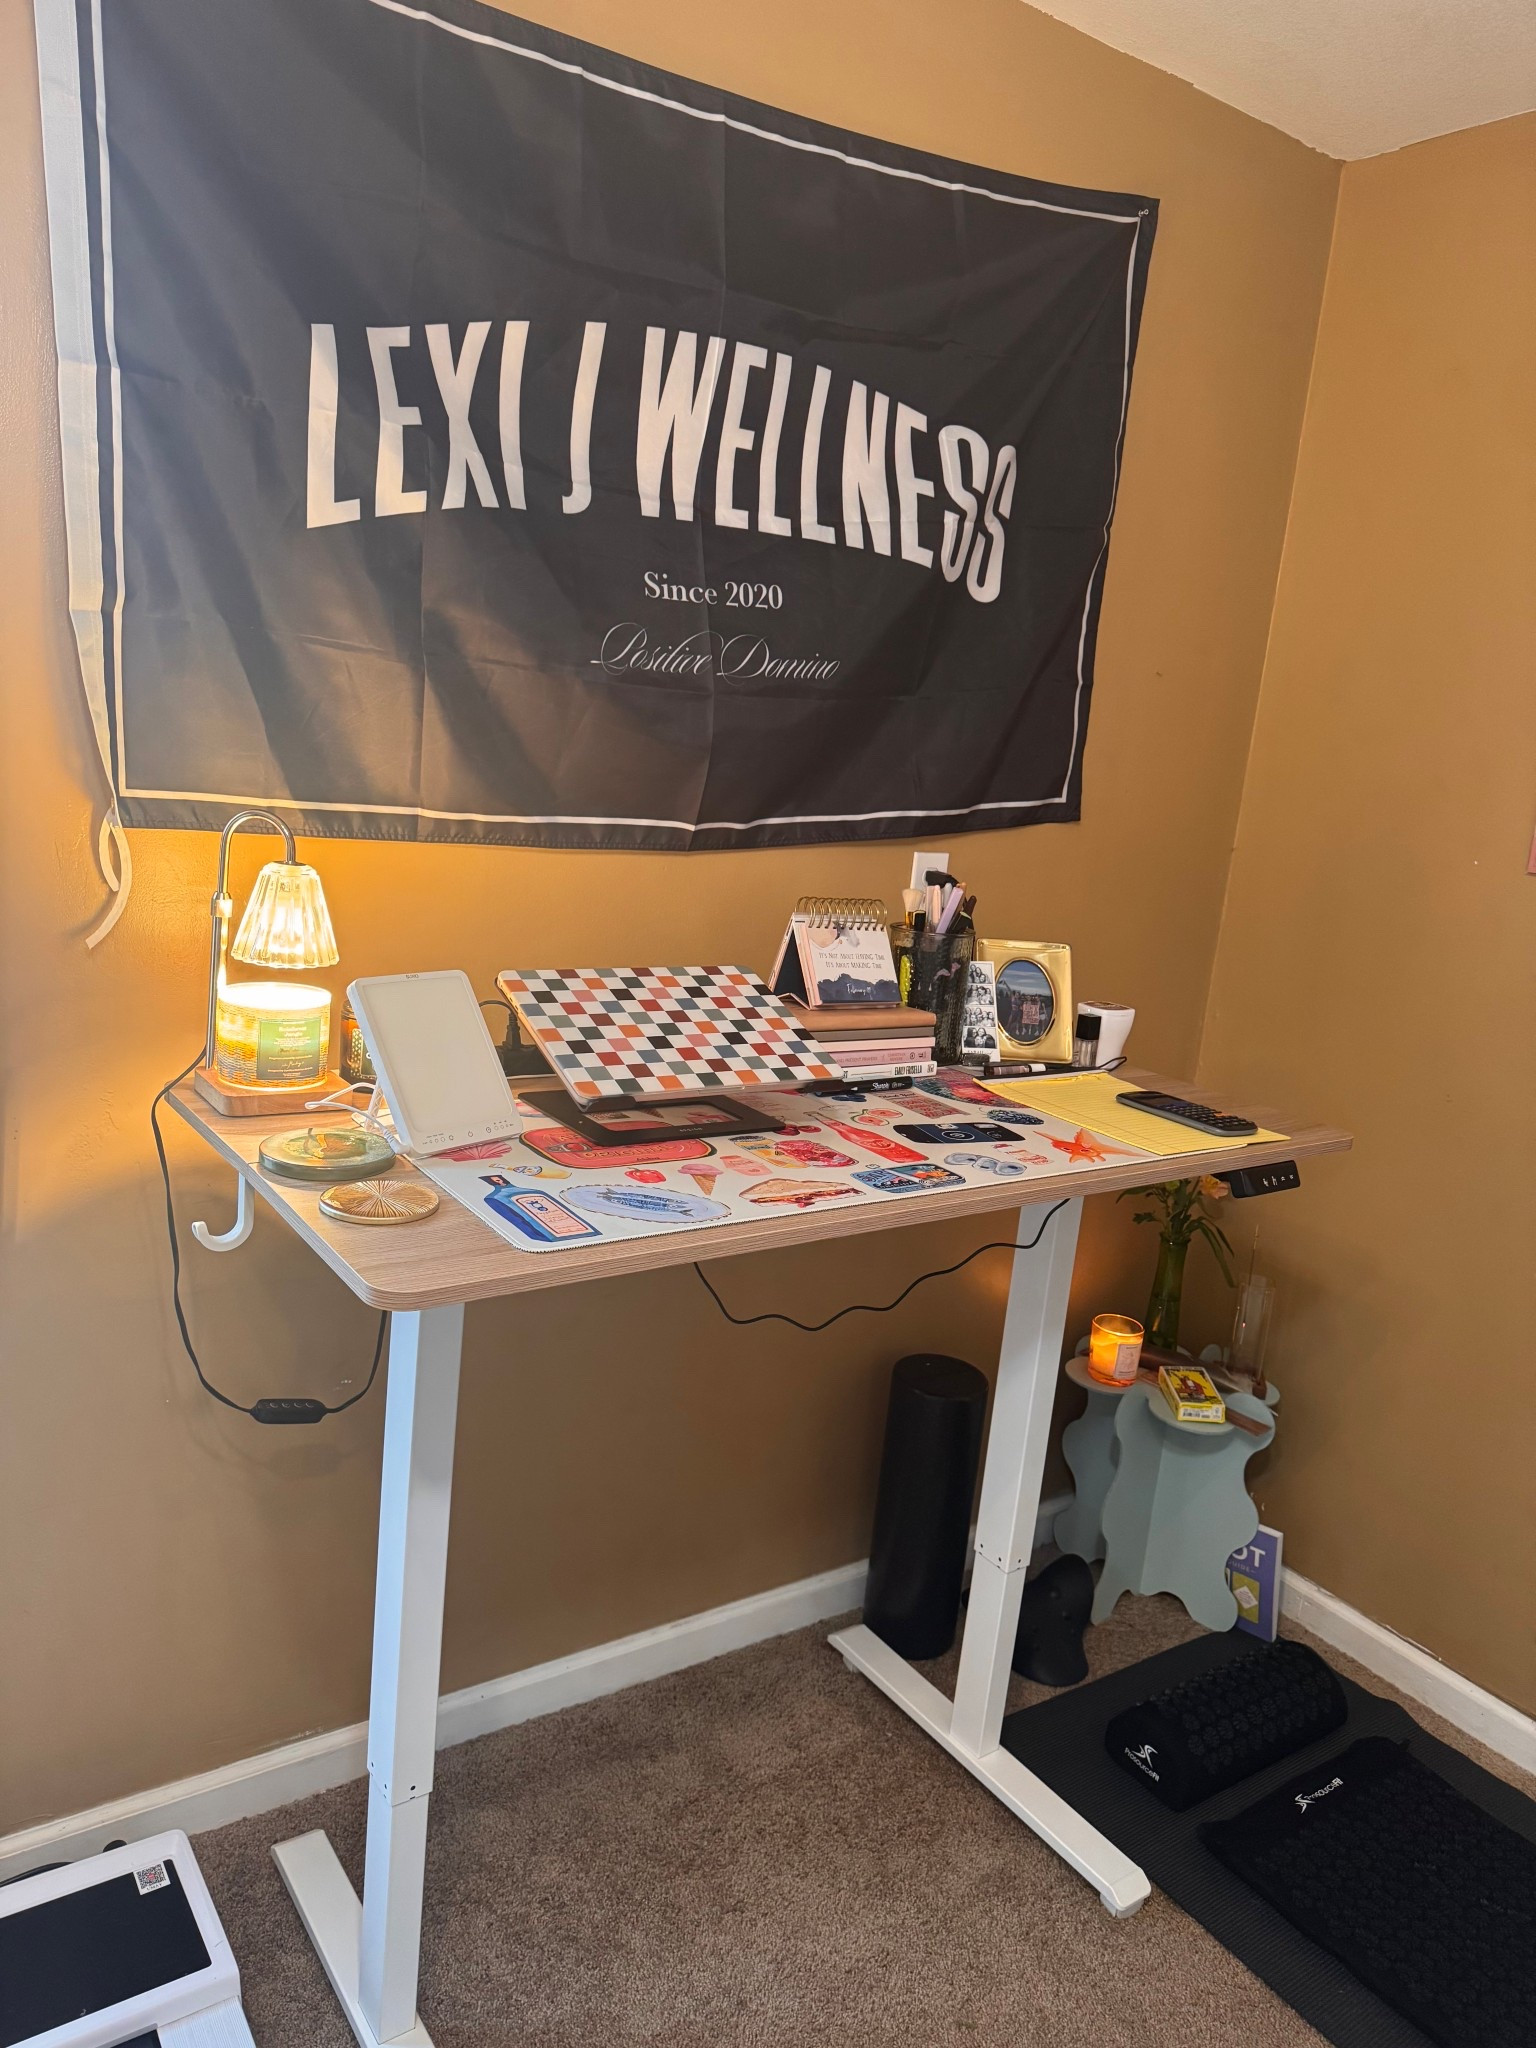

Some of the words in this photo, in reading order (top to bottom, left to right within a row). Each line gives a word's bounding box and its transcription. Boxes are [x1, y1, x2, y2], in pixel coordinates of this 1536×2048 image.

[307, 321, 530, 528] LEXI
[562, 321, 607, 515] J
[636, 325, 1018, 604] WELLNESS
[643, 571, 718, 604] Since
[724, 581, 783, 609] 2020
[590, 622, 725, 675] Positive
[716, 633, 841, 686] Domino
[894, 1066, 906, 1076] EMILY
